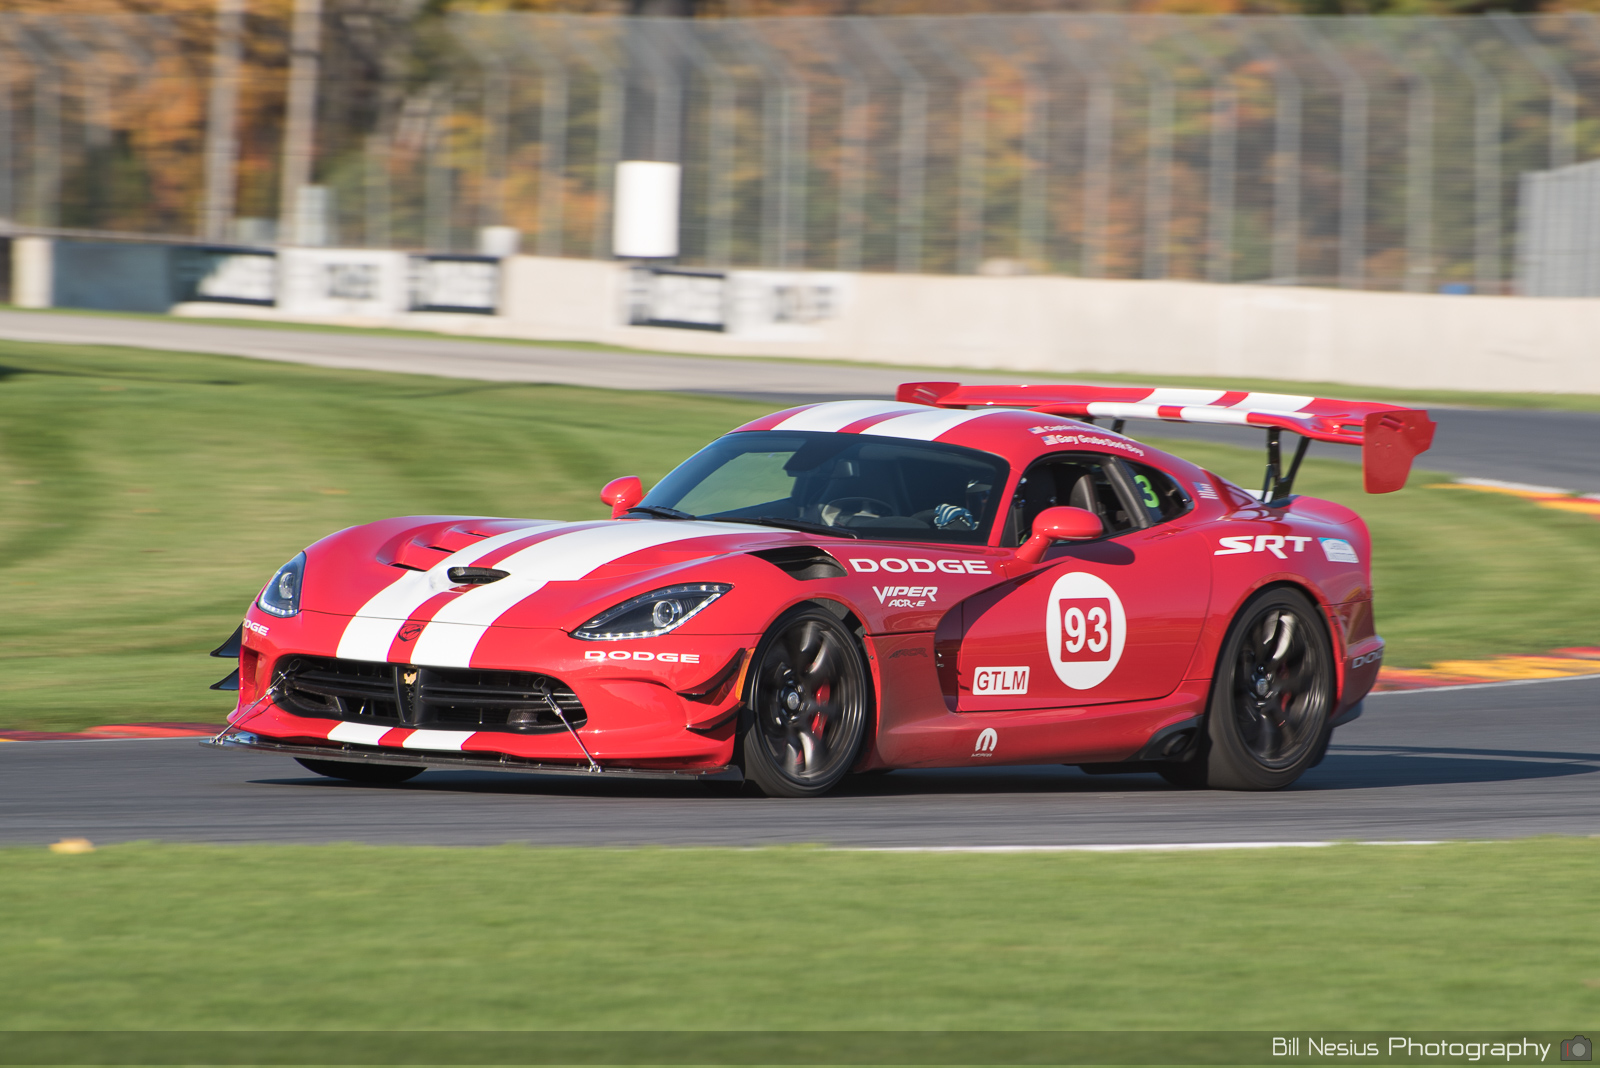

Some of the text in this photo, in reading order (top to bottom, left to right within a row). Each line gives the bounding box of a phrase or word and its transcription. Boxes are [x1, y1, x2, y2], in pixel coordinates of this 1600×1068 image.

[1134, 474, 1160, 508] 3
[1213, 535, 1313, 559] SRT
[848, 558, 992, 575] DODGE
[872, 586, 938, 604] VIPER
[888, 599, 926, 608] ACR-E
[1064, 606, 1109, 654] 93
[584, 650, 700, 664] DODGE
[976, 670, 1027, 691] GTLM
